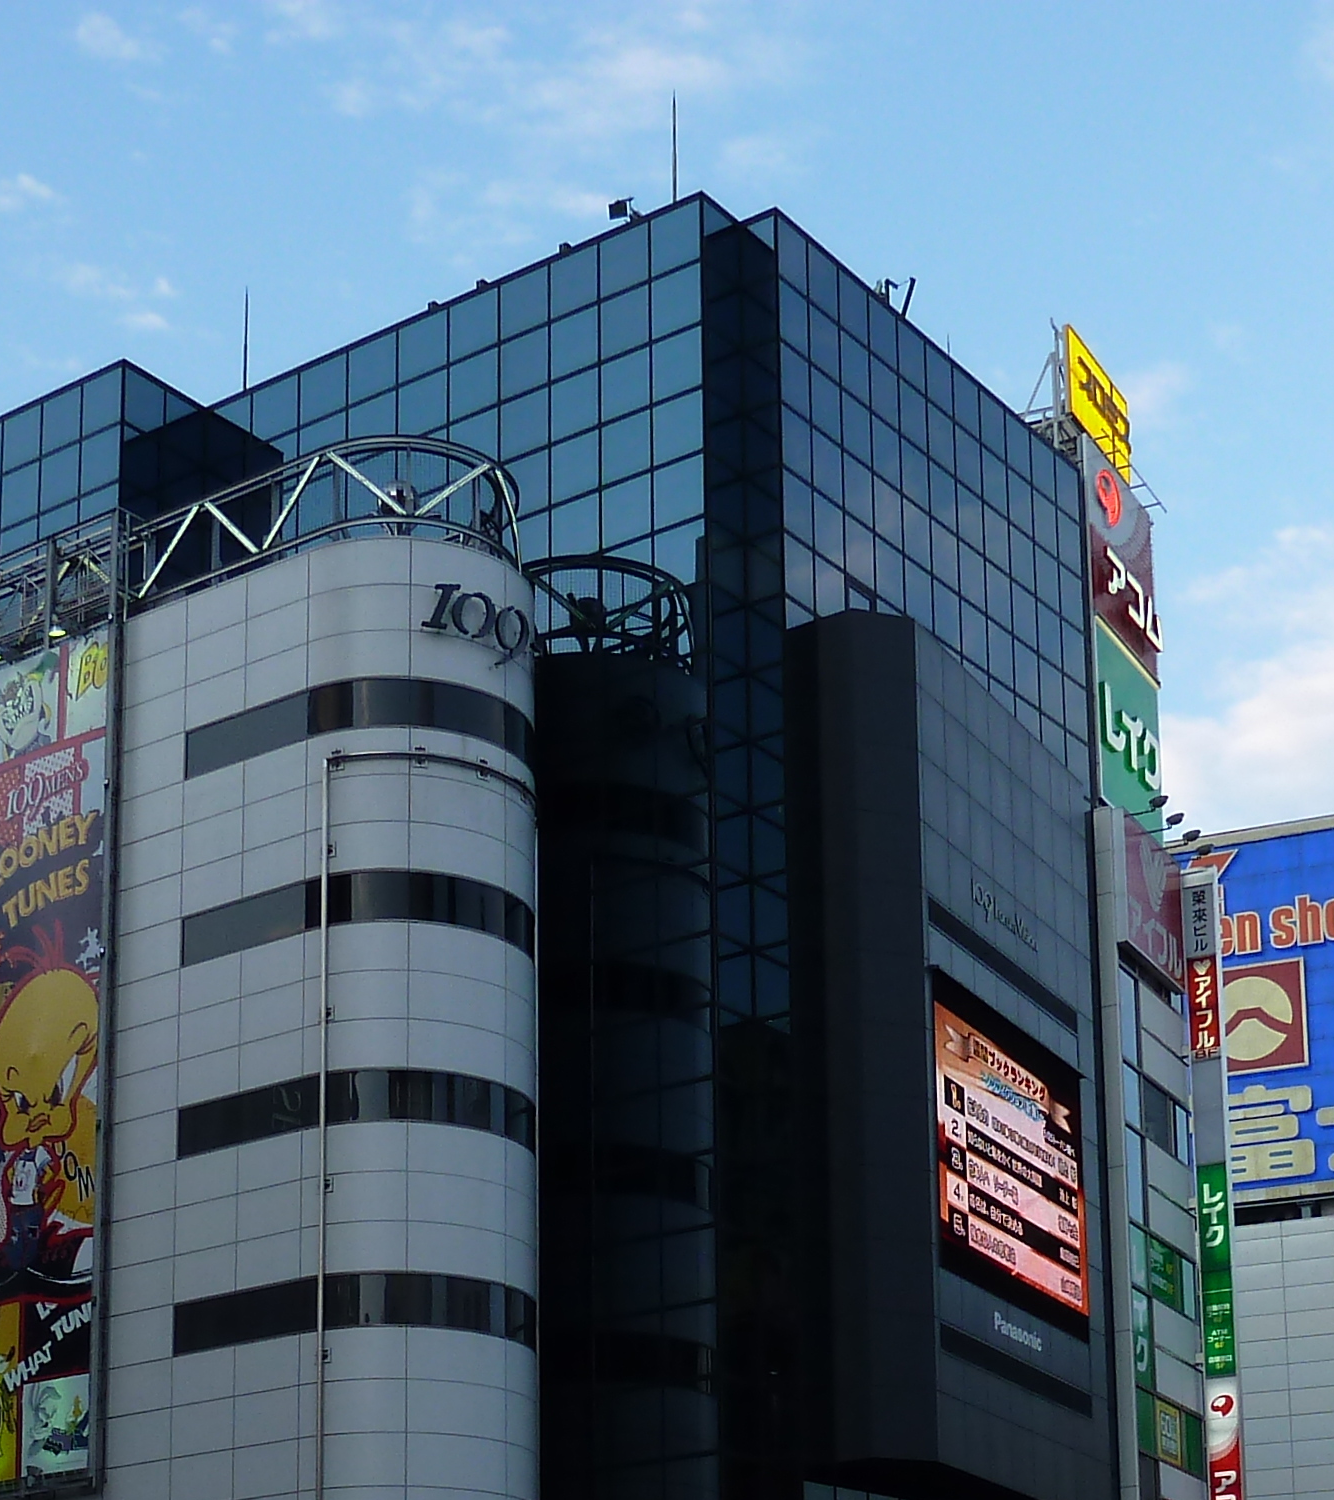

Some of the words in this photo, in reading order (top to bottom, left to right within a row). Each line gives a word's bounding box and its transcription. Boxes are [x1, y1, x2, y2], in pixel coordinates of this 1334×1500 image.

[1105, 546, 1163, 653] アコム
[2, 858, 91, 929] TUNES
[1194, 976, 1216, 1050] アイフル
[1202, 1183, 1225, 1248] レイク
[993, 1310, 1042, 1352] Panasonic
[1, 1339, 54, 1394] WHAT
